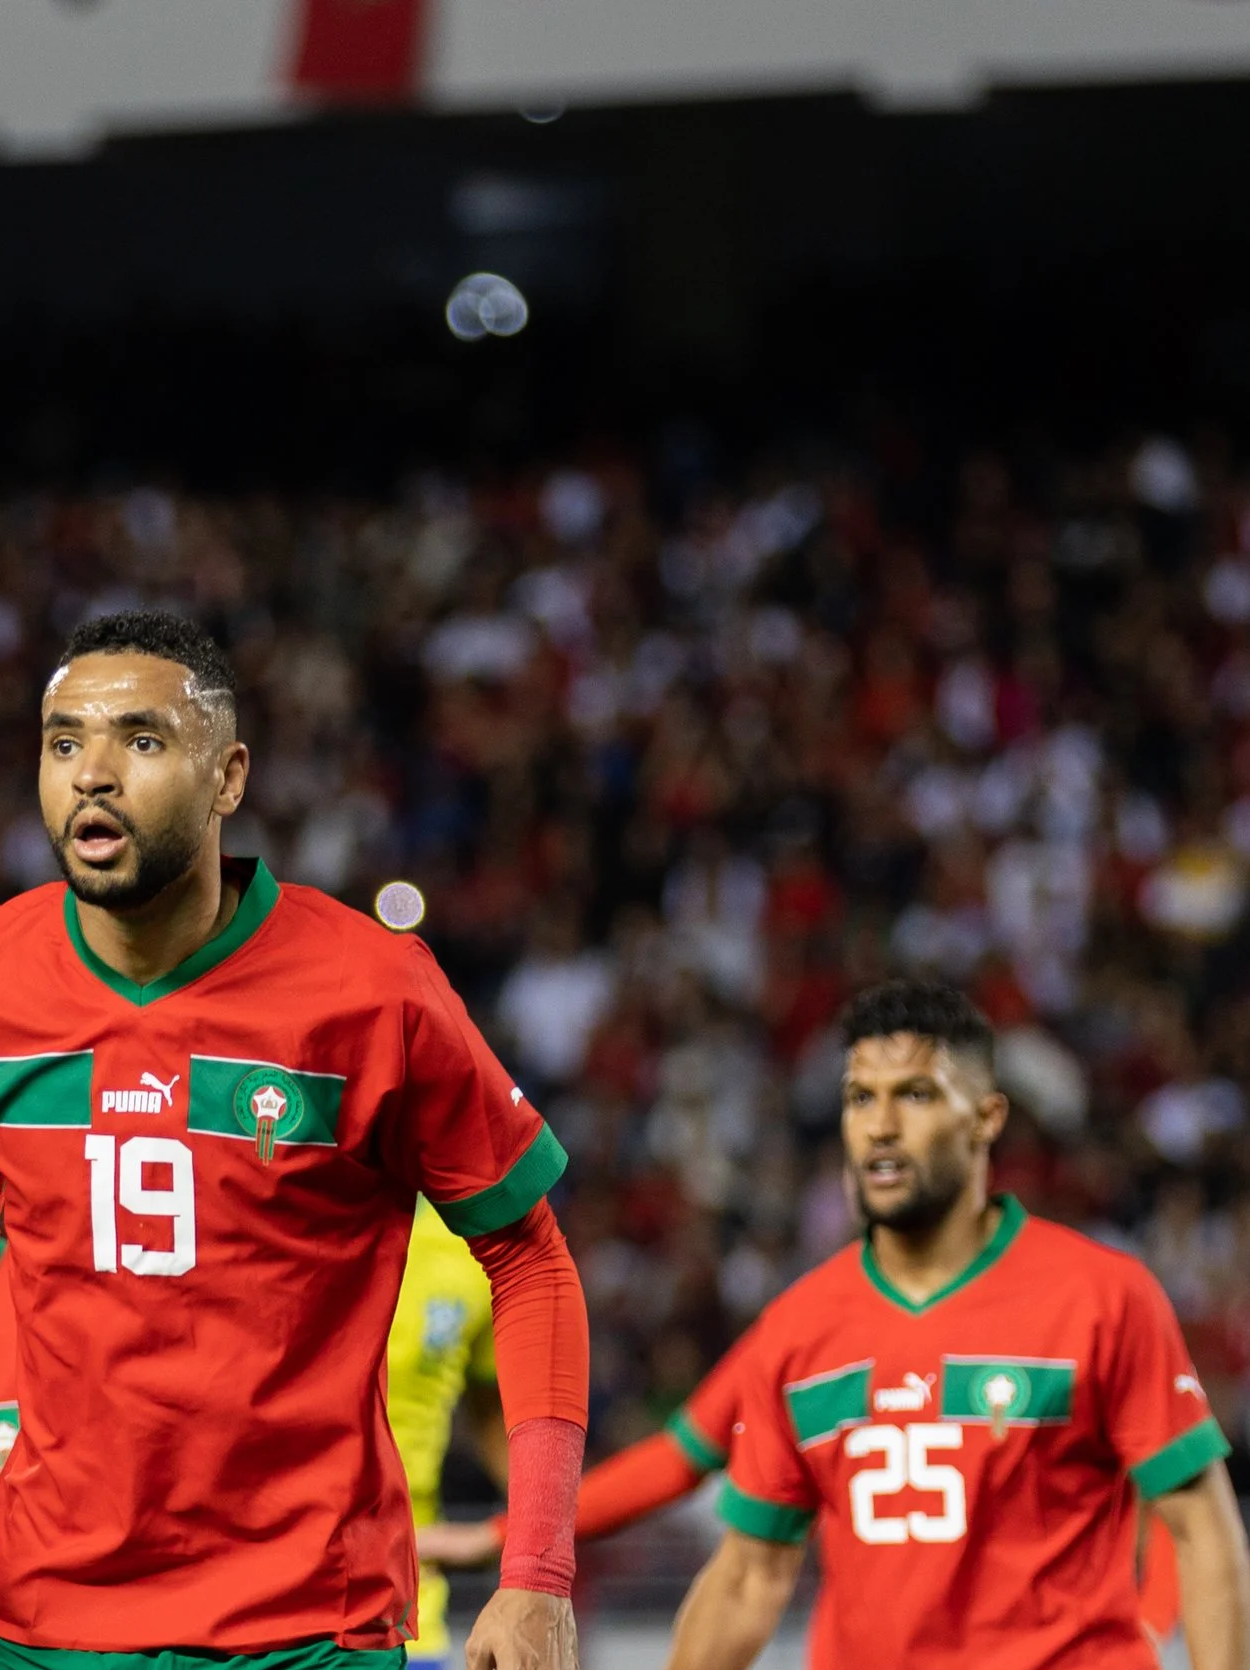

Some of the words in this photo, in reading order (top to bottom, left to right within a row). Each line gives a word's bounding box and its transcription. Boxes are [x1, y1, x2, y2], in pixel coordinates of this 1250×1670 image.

[102, 1091, 162, 1114] PUMA
[84, 1133, 196, 1277] 19
[845, 1423, 967, 1545] 25
